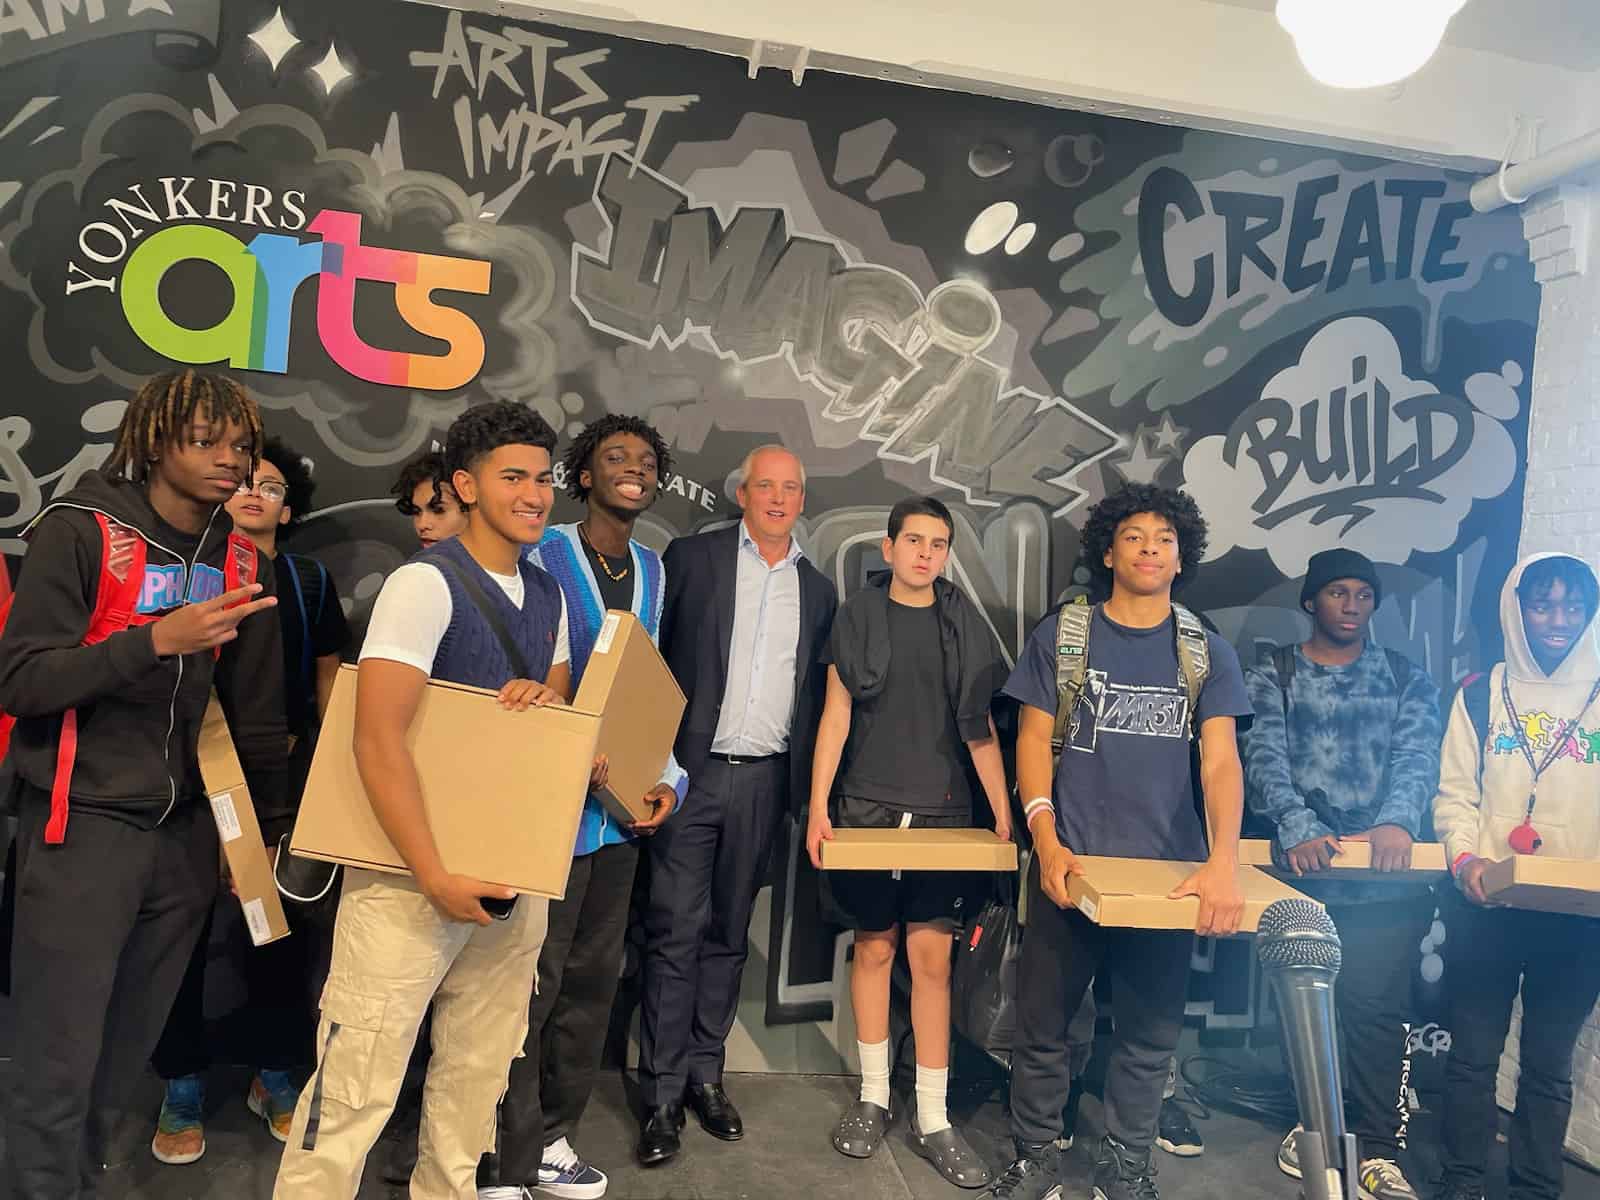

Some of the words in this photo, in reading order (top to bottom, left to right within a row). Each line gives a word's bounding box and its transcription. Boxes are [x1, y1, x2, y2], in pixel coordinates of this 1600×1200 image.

[410, 10, 611, 114] ARTS
[454, 94, 699, 180] IMPACT
[66, 176, 308, 296] YONKERS
[120, 208, 492, 391] arts
[1138, 166, 1473, 328] CREATE
[1222, 355, 1476, 516] BUILD
